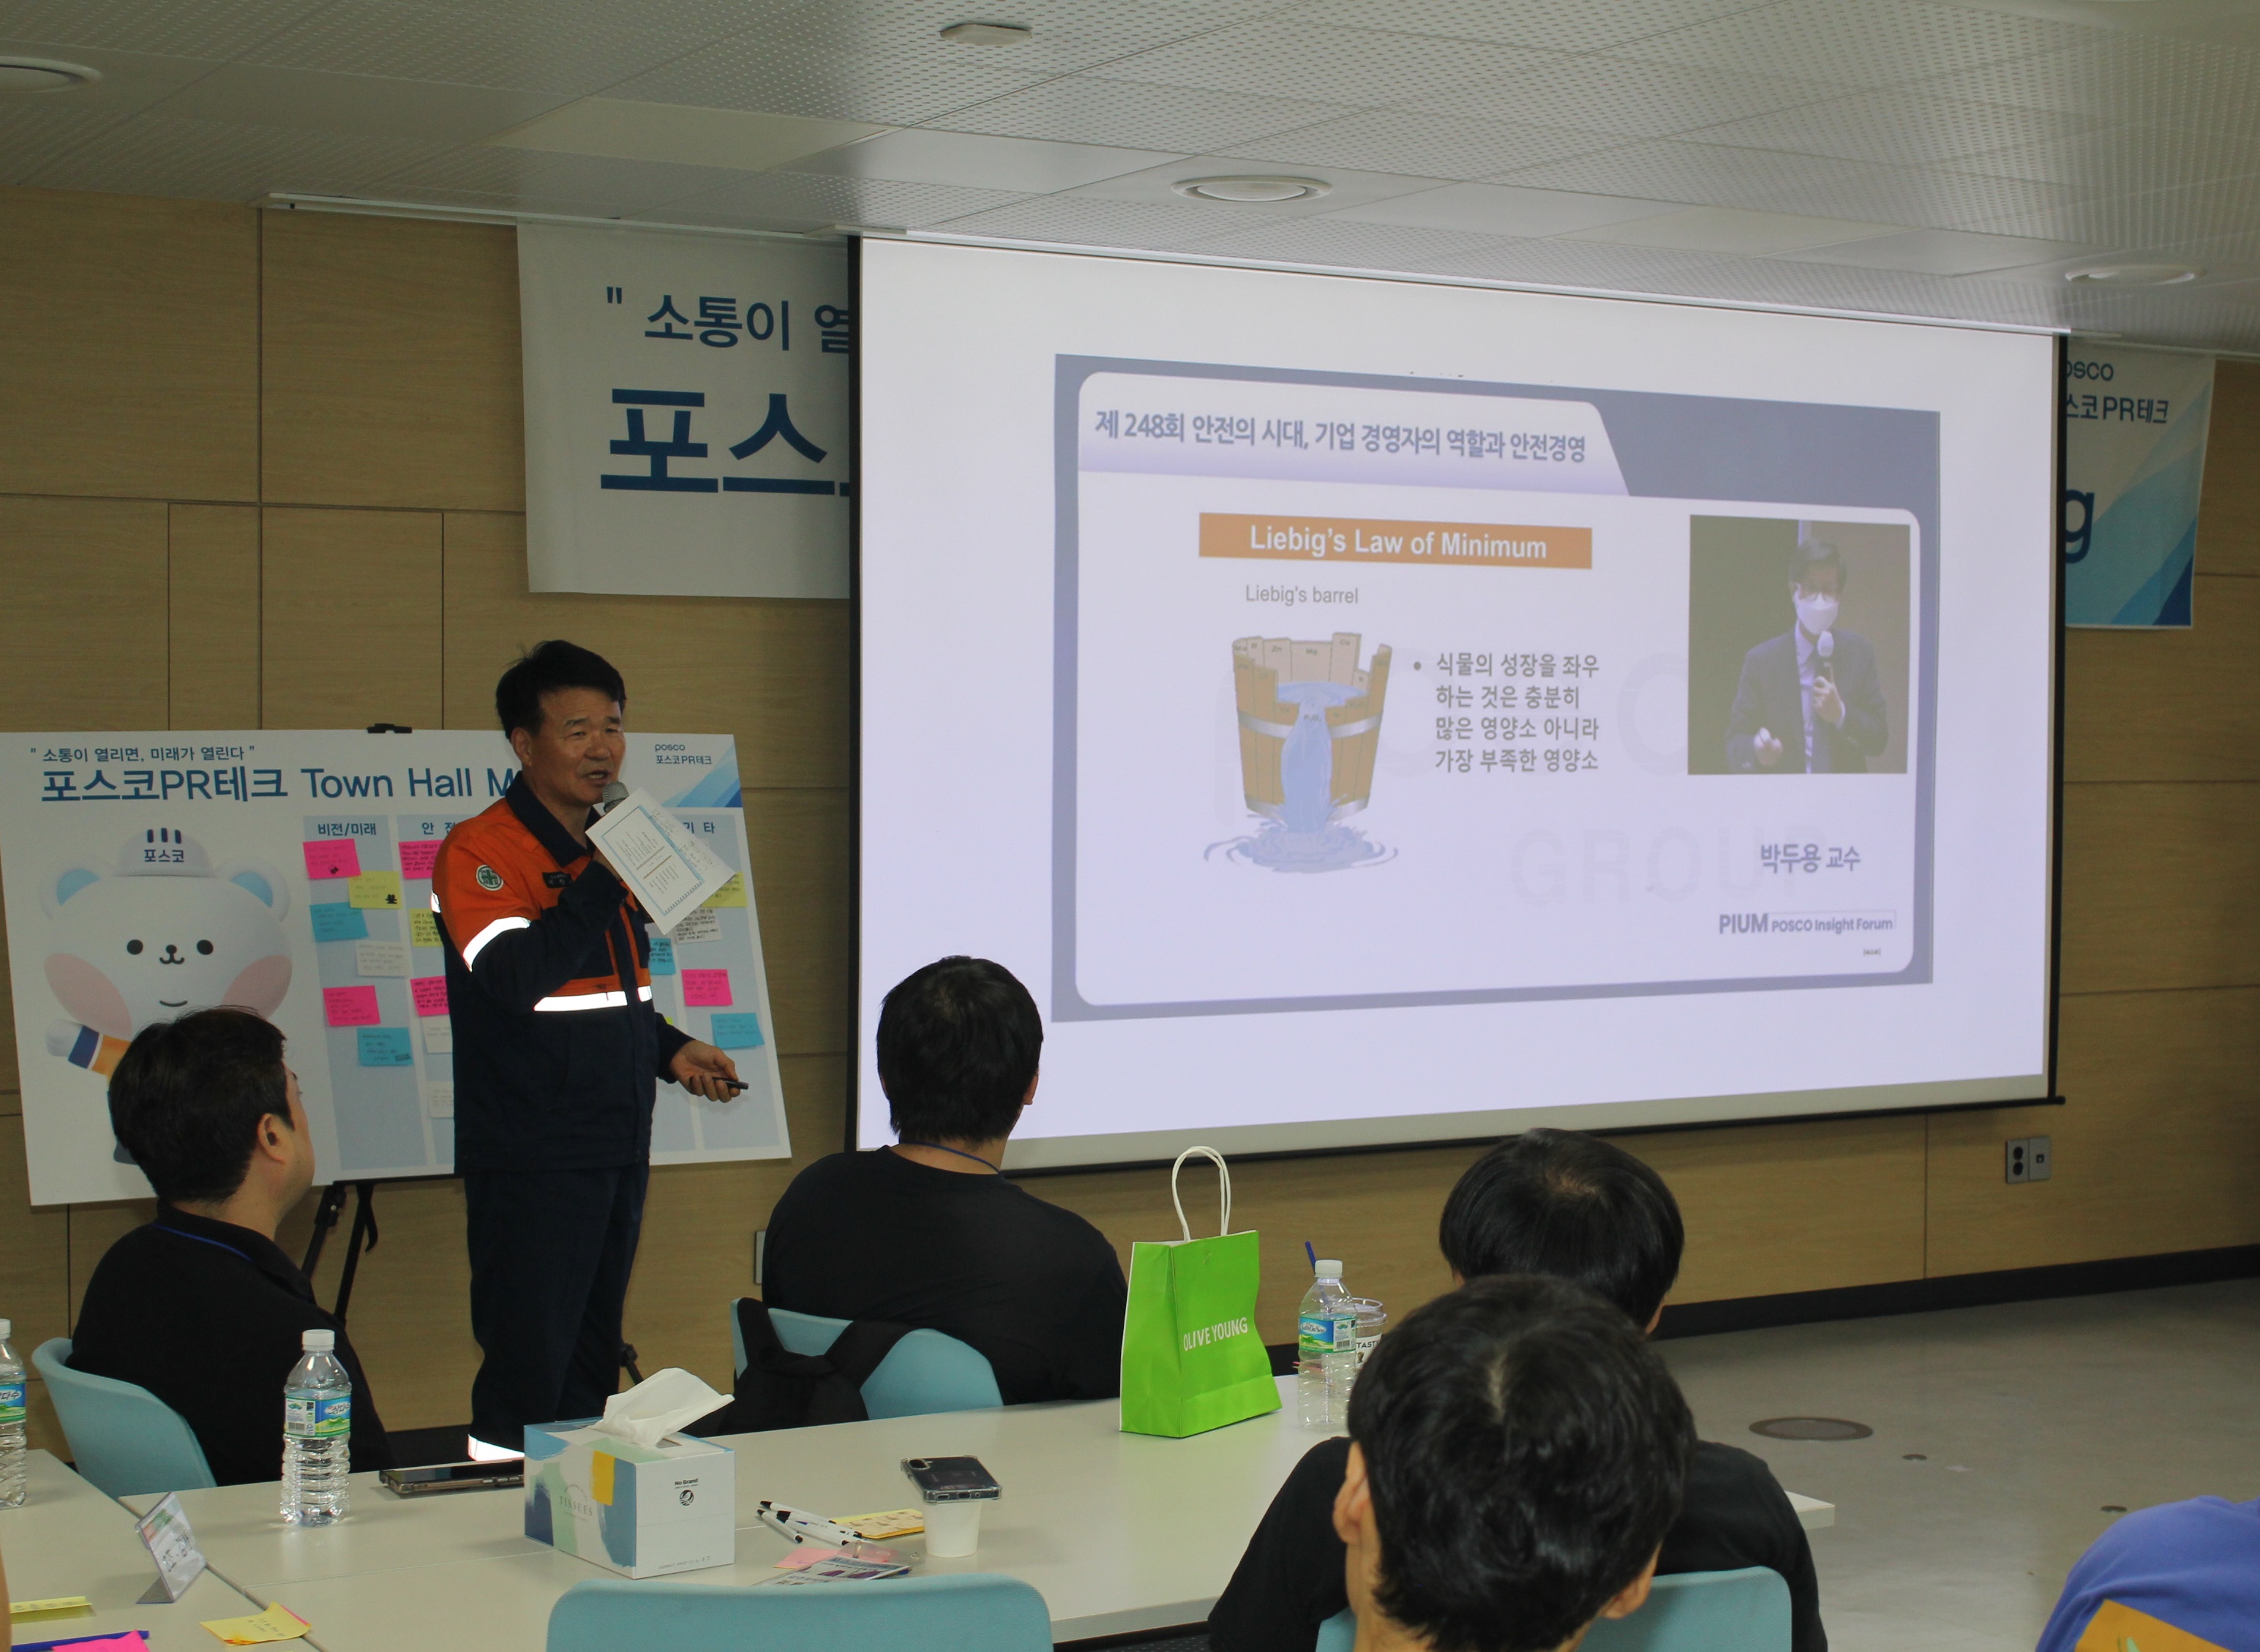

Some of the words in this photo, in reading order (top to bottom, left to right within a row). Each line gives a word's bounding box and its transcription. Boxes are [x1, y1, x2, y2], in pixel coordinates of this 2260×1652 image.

[645, 295, 789, 351] 소통이
[600, 388, 850, 498] 포스
[1095, 410, 1119, 440] 제
[1124, 413, 1185, 443] 248회
[1192, 415, 1255, 446] 안전의
[1262, 418, 1310, 451] 시대,
[1315, 421, 1355, 451] 기업
[1362, 424, 1441, 456] 경영자의
[1446, 428, 1506, 459] 역할과
[1510, 432, 1586, 463] 안전경영
[1354, 527, 1404, 555] Law
[1411, 530, 1435, 556] of
[1441, 532, 1547, 559] Minimum
[1245, 584, 1307, 607] Liebig's
[1313, 585, 1359, 605] barrel
[1436, 652, 1493, 677] 식물의
[1500, 653, 1557, 678] 성장을
[1561, 654, 1600, 679] 좌우
[1435, 685, 1473, 709] 하는
[1481, 685, 1518, 710] 것은
[1524, 686, 1580, 710] 충분히
[1435, 716, 1473, 741] 많은
[1481, 716, 1537, 741] 영양소
[1543, 716, 1600, 741] 아니라
[42, 747, 89, 762] 소통이
[94, 747, 145, 763] 열리면,
[151, 746, 195, 762] 미래가
[200, 746, 244, 761] 열린다
[655, 743, 686, 753] posco
[1435, 748, 1473, 773] 가장
[1479, 748, 1538, 773] 부족한
[1543, 748, 1599, 773] 영양소
[41, 765, 289, 803] 포스코PR테크
[301, 767, 394, 798] Town
[408, 767, 473, 797] Hall
[318, 822, 377, 837] 비전/미래
[143, 849, 185, 863] 포스코
[1760, 843, 1822, 874] 박두용
[1825, 846, 1861, 872] 교수
[1719, 912, 1768, 934] PIUM
[1814, 917, 1855, 935] Insight
[1856, 917, 1893, 931] Forum
[1183, 1326, 1212, 1352] OLIVE
[1211, 1316, 1249, 1343] YOUNG
[1356, 1340, 1378, 1348] TAST
[683, 1477, 699, 1485] Brand
